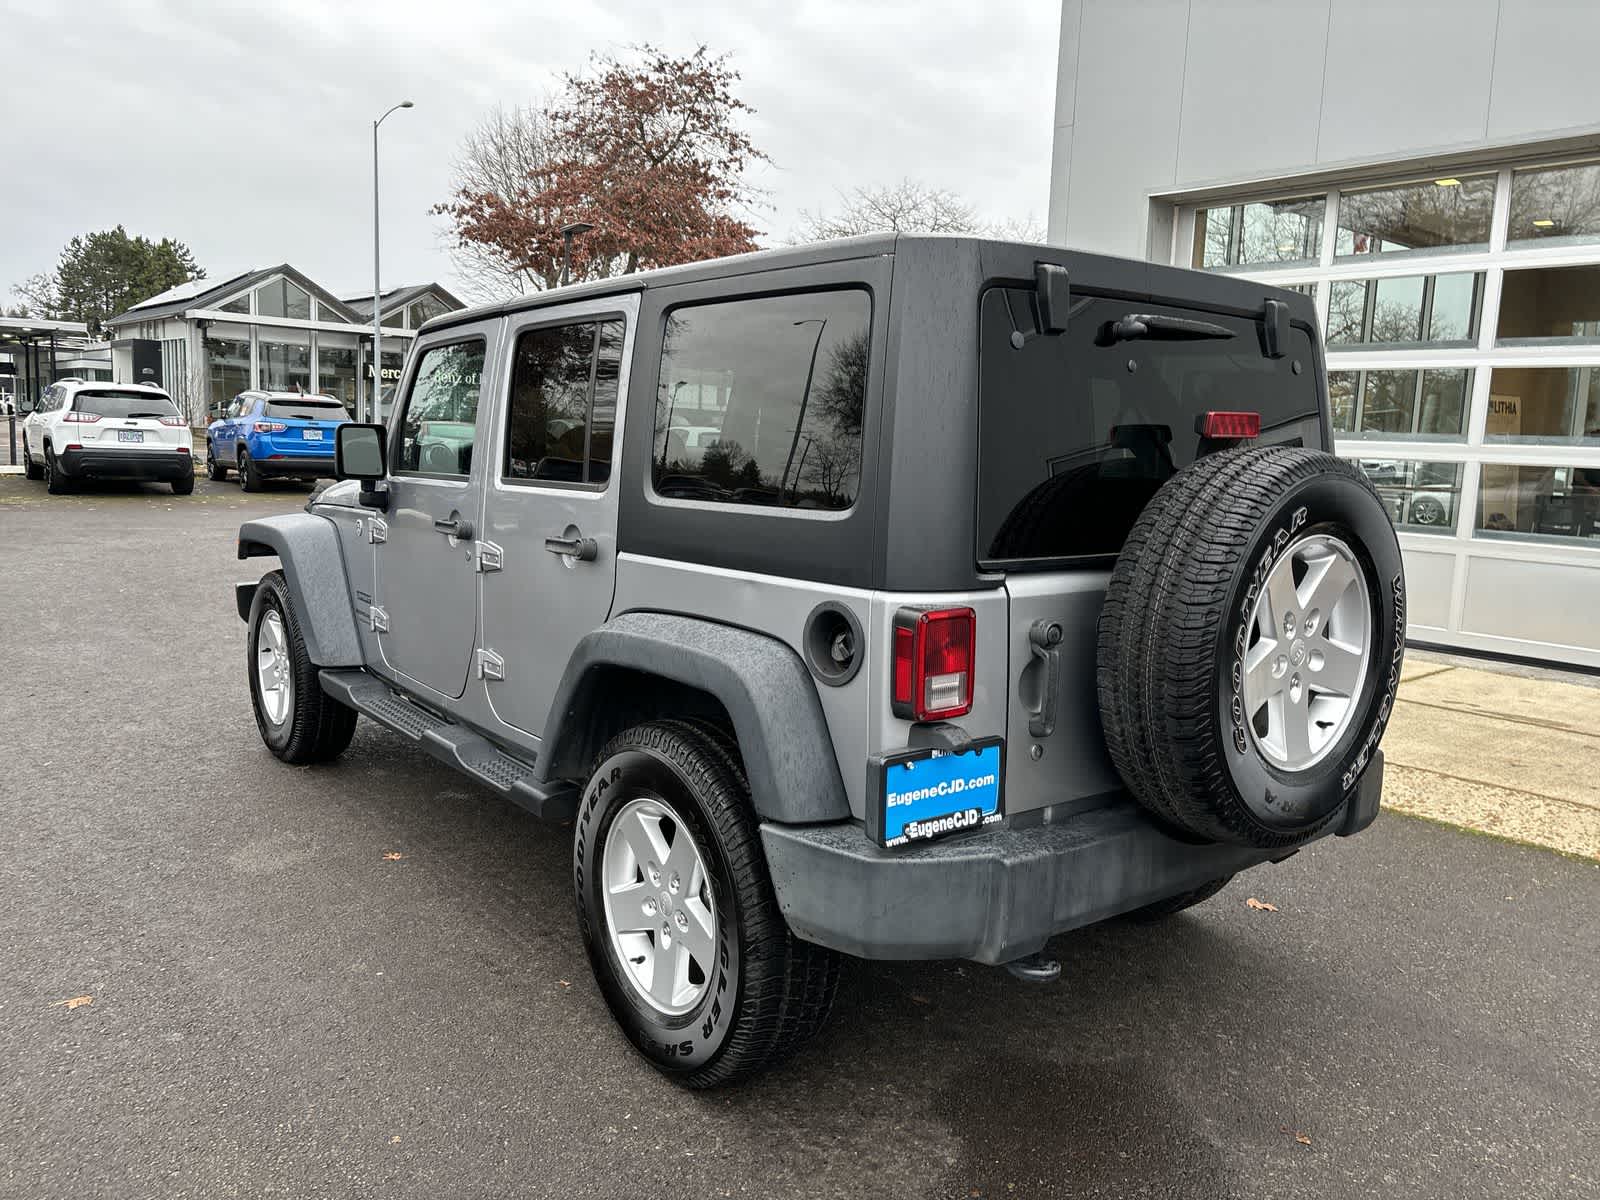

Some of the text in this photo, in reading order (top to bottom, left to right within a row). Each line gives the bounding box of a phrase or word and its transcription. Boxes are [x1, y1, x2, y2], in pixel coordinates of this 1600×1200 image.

[465, 373, 477, 384] of
[1494, 400, 1518, 415] LITHIA
[887, 774, 995, 808] EugeneCJD.com
